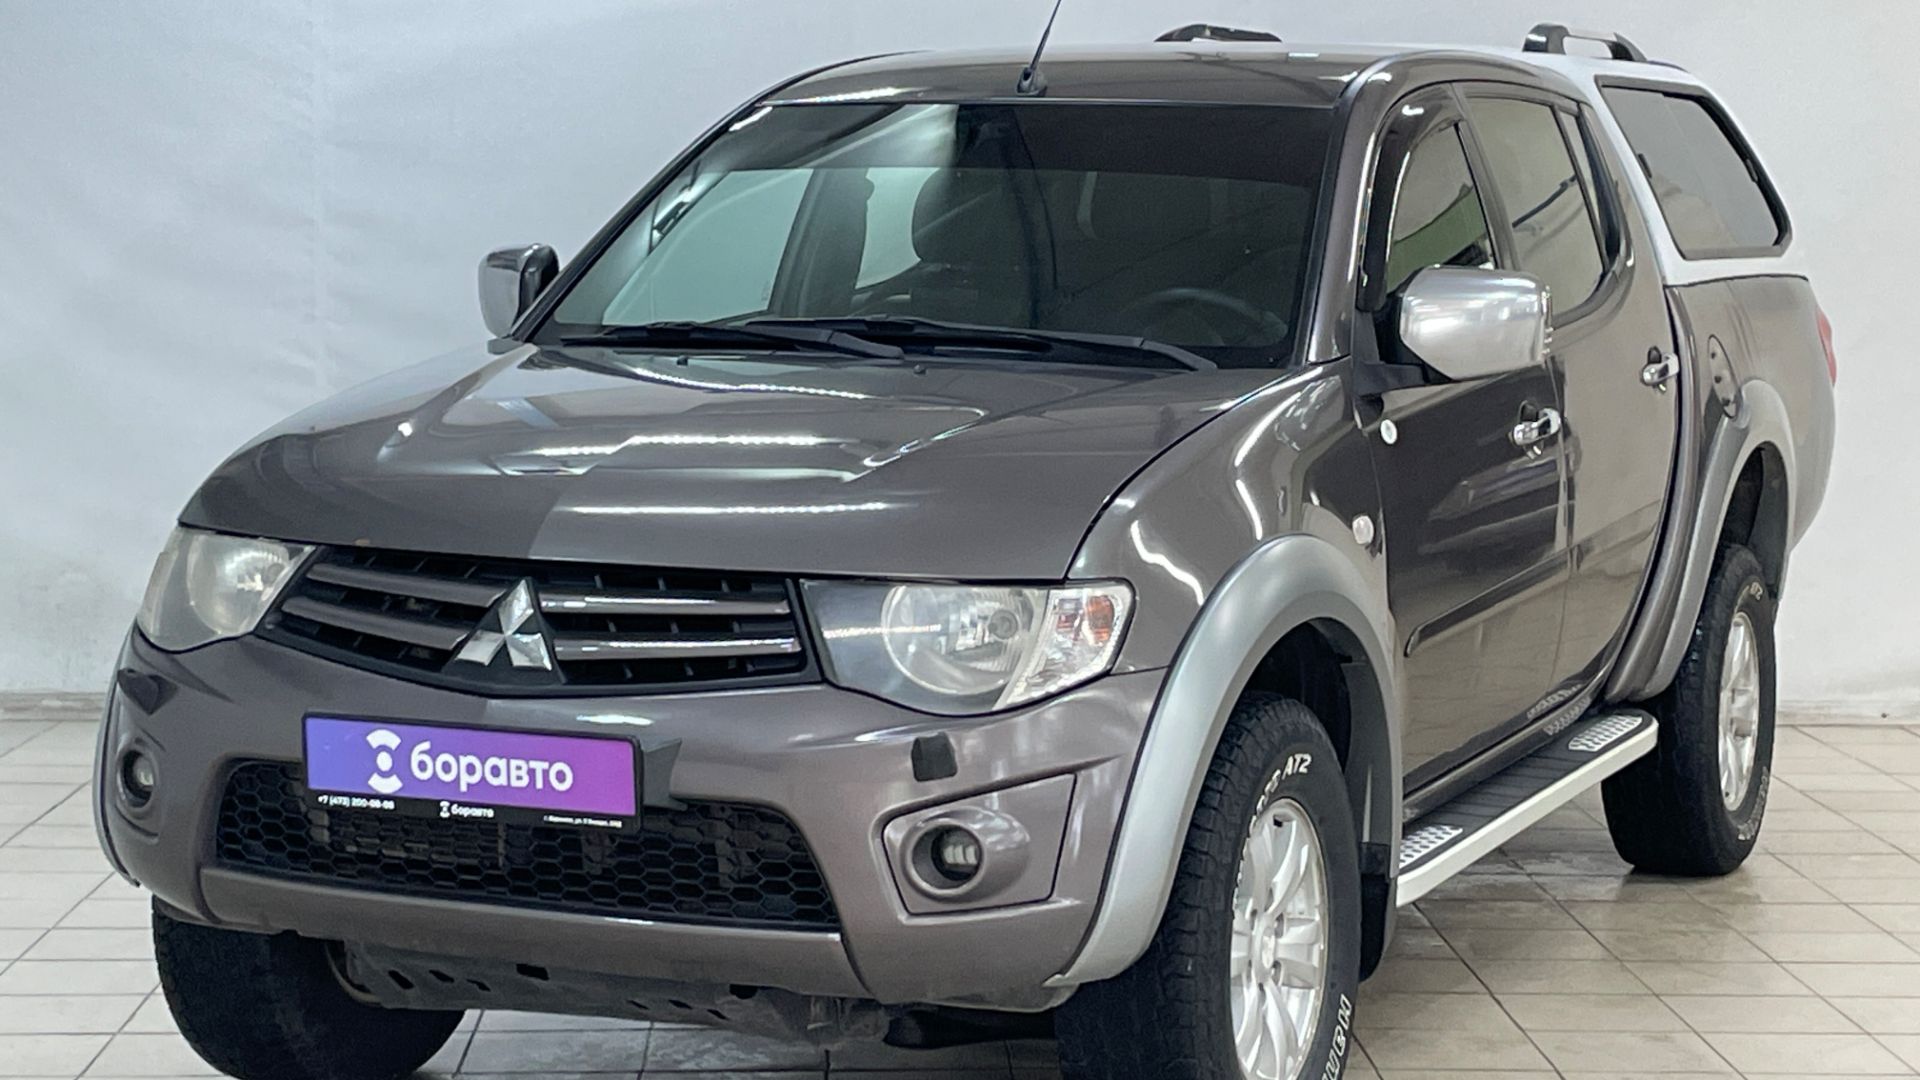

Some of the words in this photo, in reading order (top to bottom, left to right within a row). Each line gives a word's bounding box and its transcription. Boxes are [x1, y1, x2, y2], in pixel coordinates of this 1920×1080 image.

[410, 740, 574, 792] боравто
[1281, 753, 1312, 780] AT2
[451, 803, 494, 818] боравто
